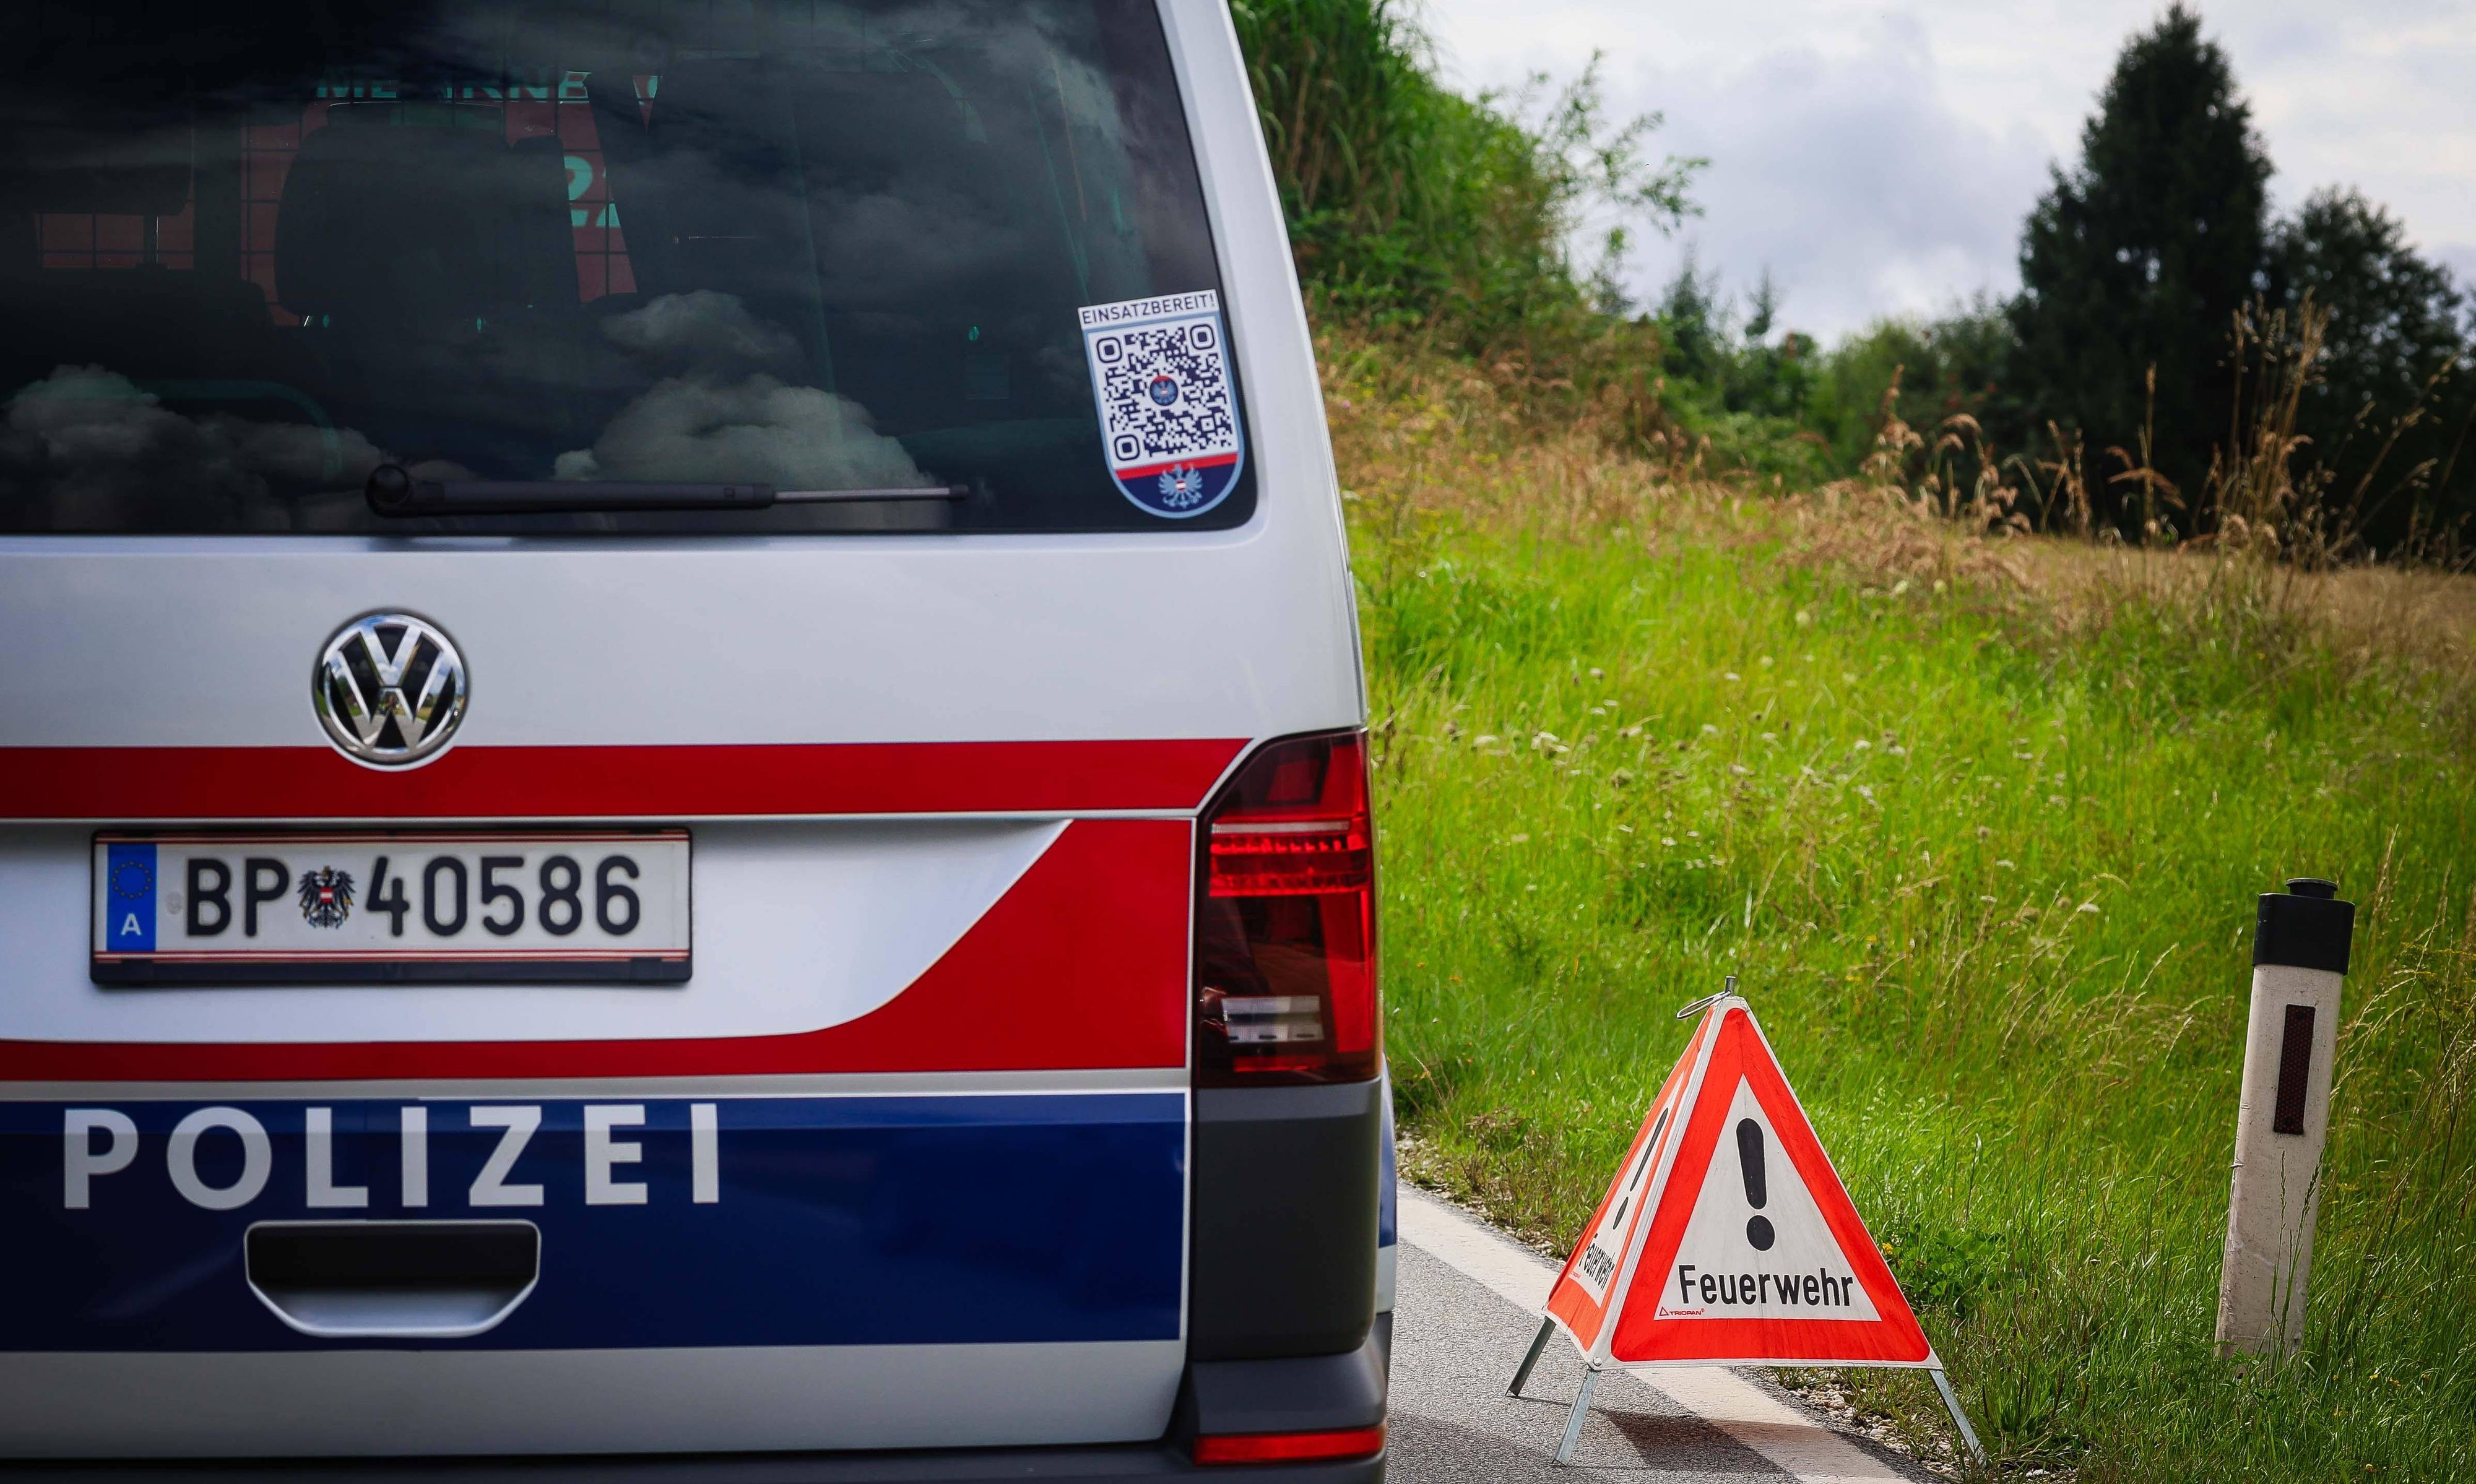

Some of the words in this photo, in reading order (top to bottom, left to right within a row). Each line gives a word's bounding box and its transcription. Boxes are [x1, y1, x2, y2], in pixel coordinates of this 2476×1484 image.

[1083, 295, 1215, 324] EINSATZBEREIT!
[186, 856, 291, 937] BP
[365, 855, 641, 937] 40586
[121, 913, 142, 935] A
[63, 1103, 720, 1210] POLIZEI
[1679, 1264, 1855, 1306] Feuerwehr
